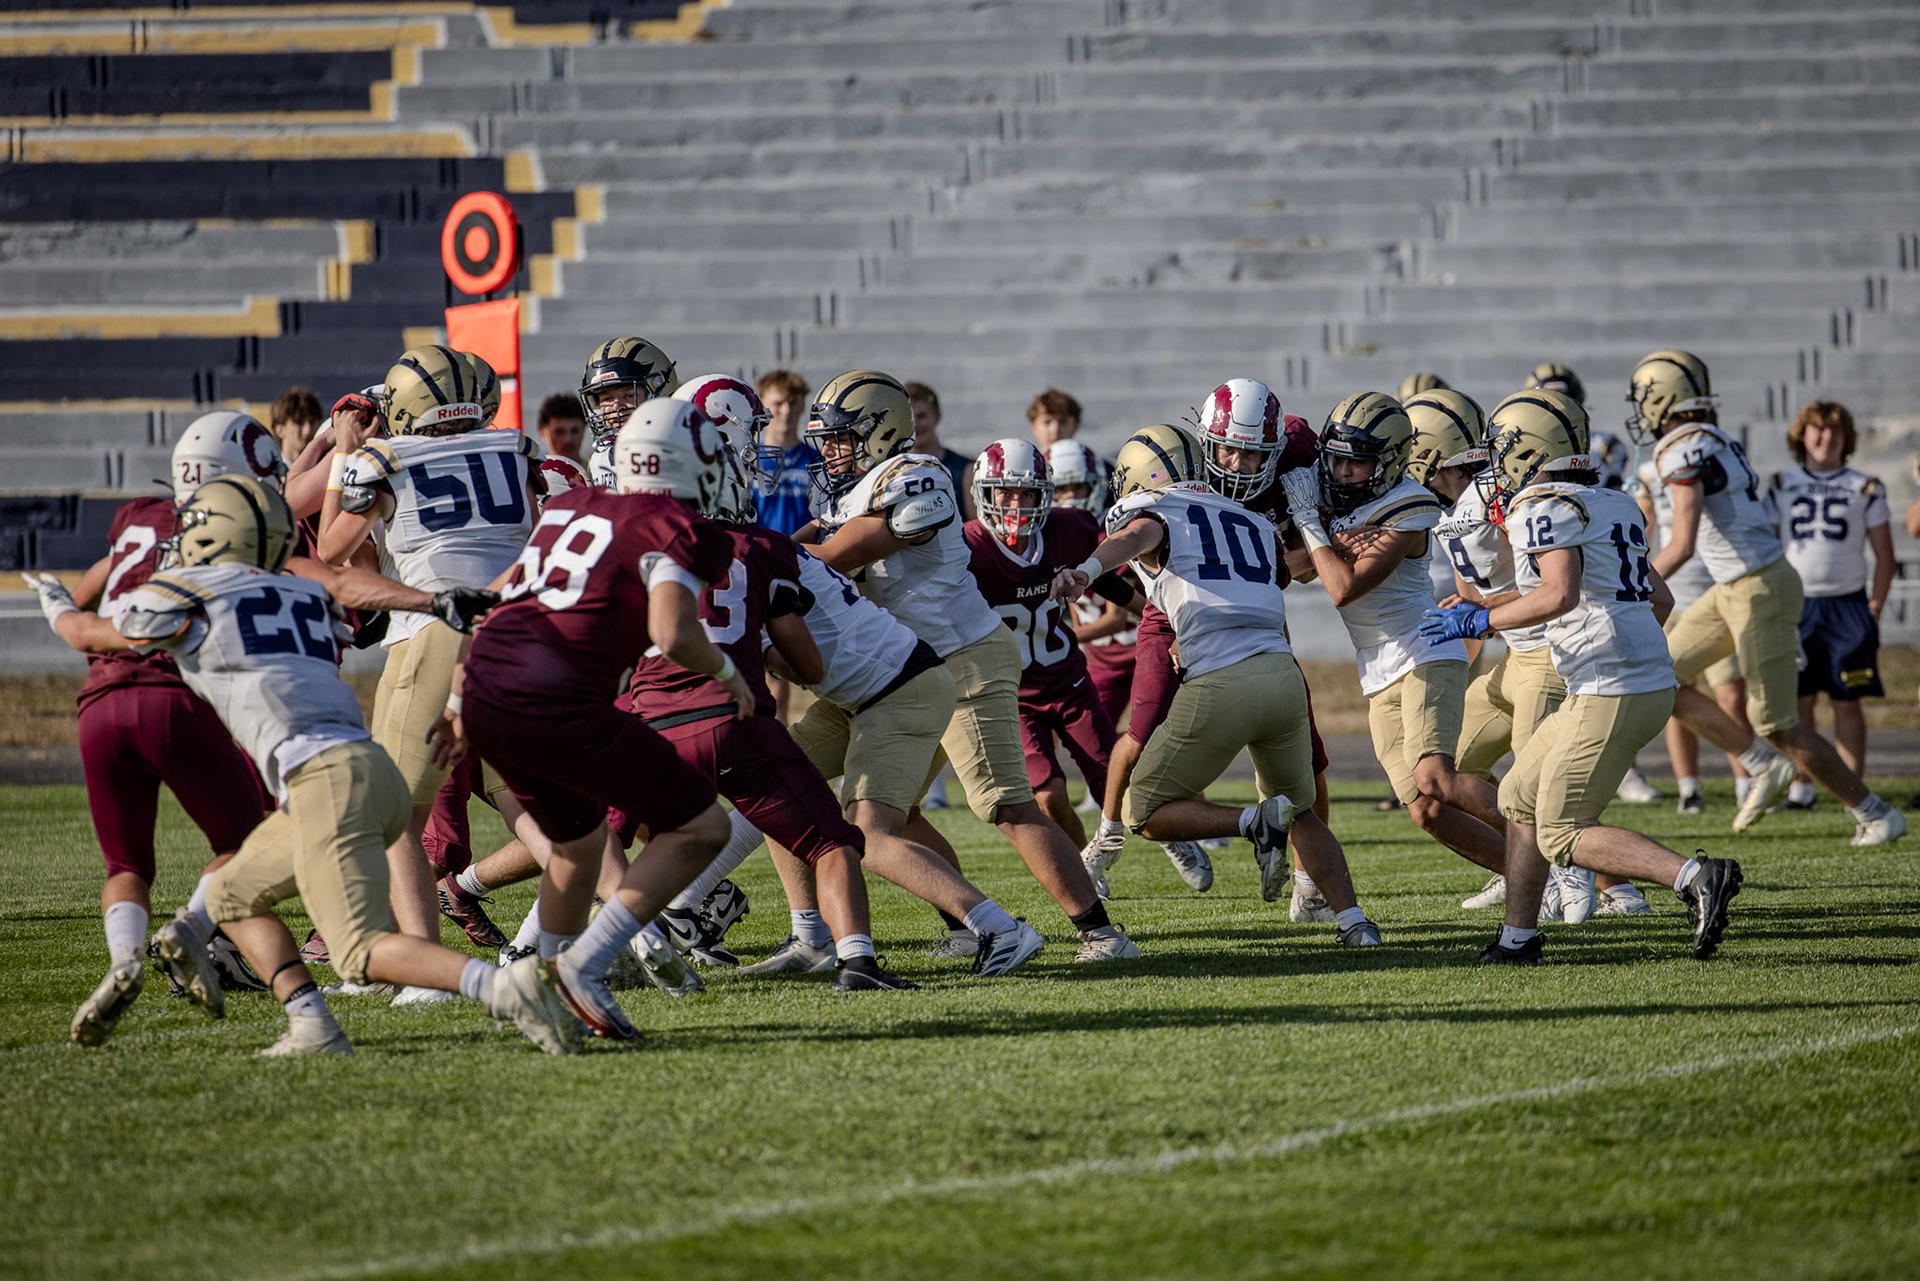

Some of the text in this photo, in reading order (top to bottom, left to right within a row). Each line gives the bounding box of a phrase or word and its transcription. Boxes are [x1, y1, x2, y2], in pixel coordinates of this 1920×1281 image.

[437, 405, 479, 419] Riddell
[182, 461, 202, 485] 21
[631, 453, 660, 476] 58
[1181, 463, 1201, 475] 10
[408, 451, 525, 533] 50
[1525, 515, 1555, 548] 12
[1792, 497, 1849, 541] 25
[500, 509, 614, 611] 58
[1186, 504, 1272, 585] 10
[698, 557, 748, 645] 3
[1016, 583, 1048, 599] RAMS
[235, 586, 339, 664] 22
[437, 890, 455, 913] NIKE
